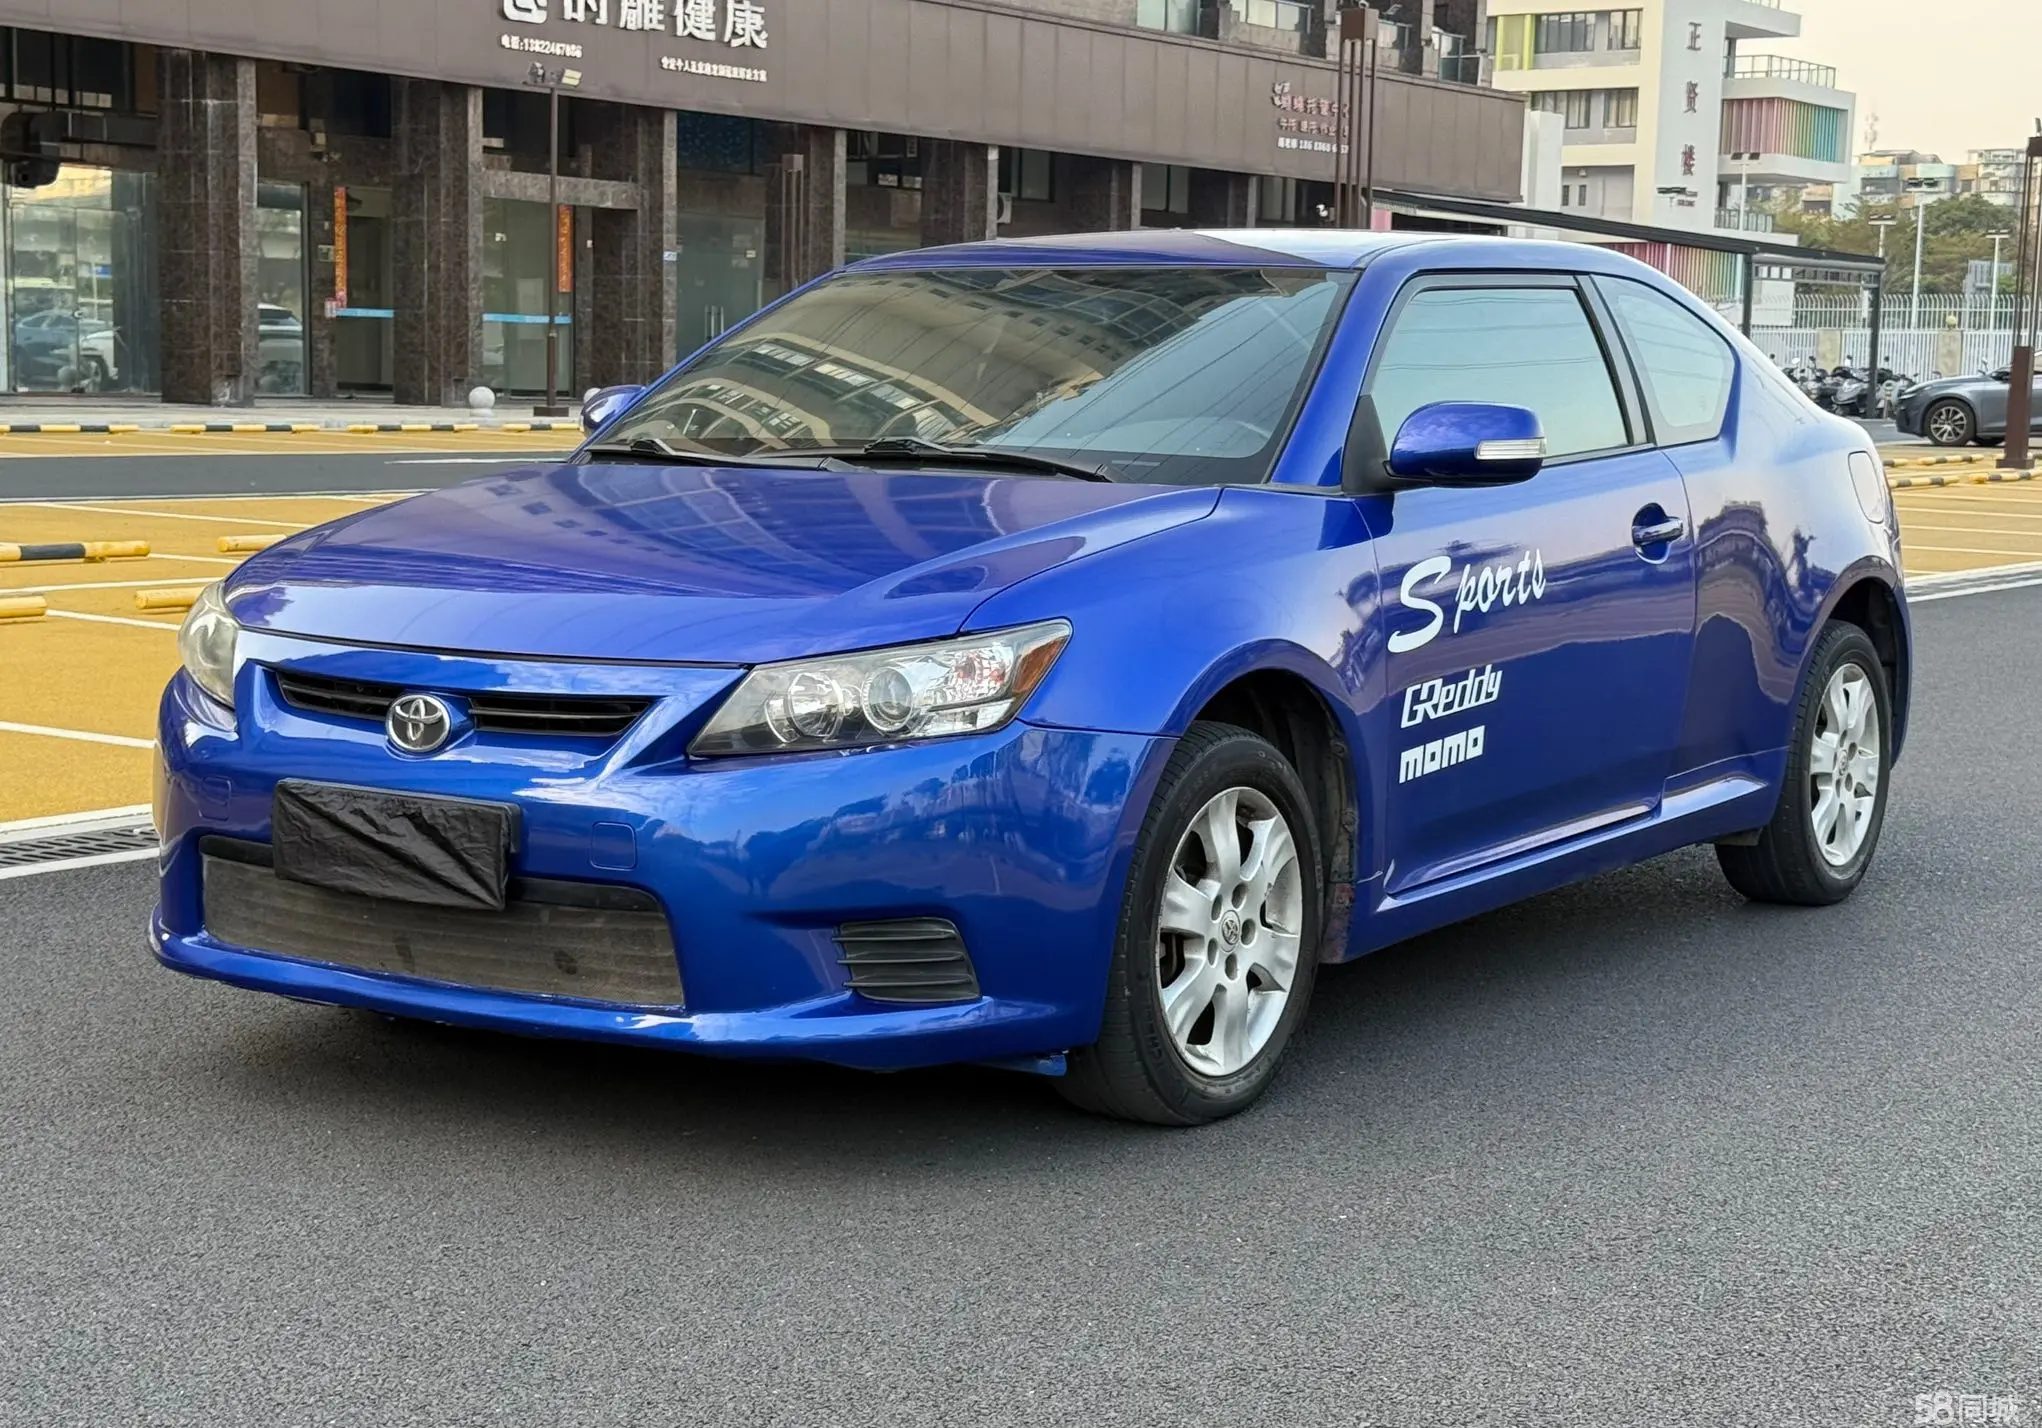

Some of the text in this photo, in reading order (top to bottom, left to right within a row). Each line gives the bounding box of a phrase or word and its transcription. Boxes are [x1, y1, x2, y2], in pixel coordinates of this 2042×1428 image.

[1387, 549, 1546, 653] Sports
[1401, 664, 1503, 728] GReddy
[1399, 725, 1485, 784] momo
